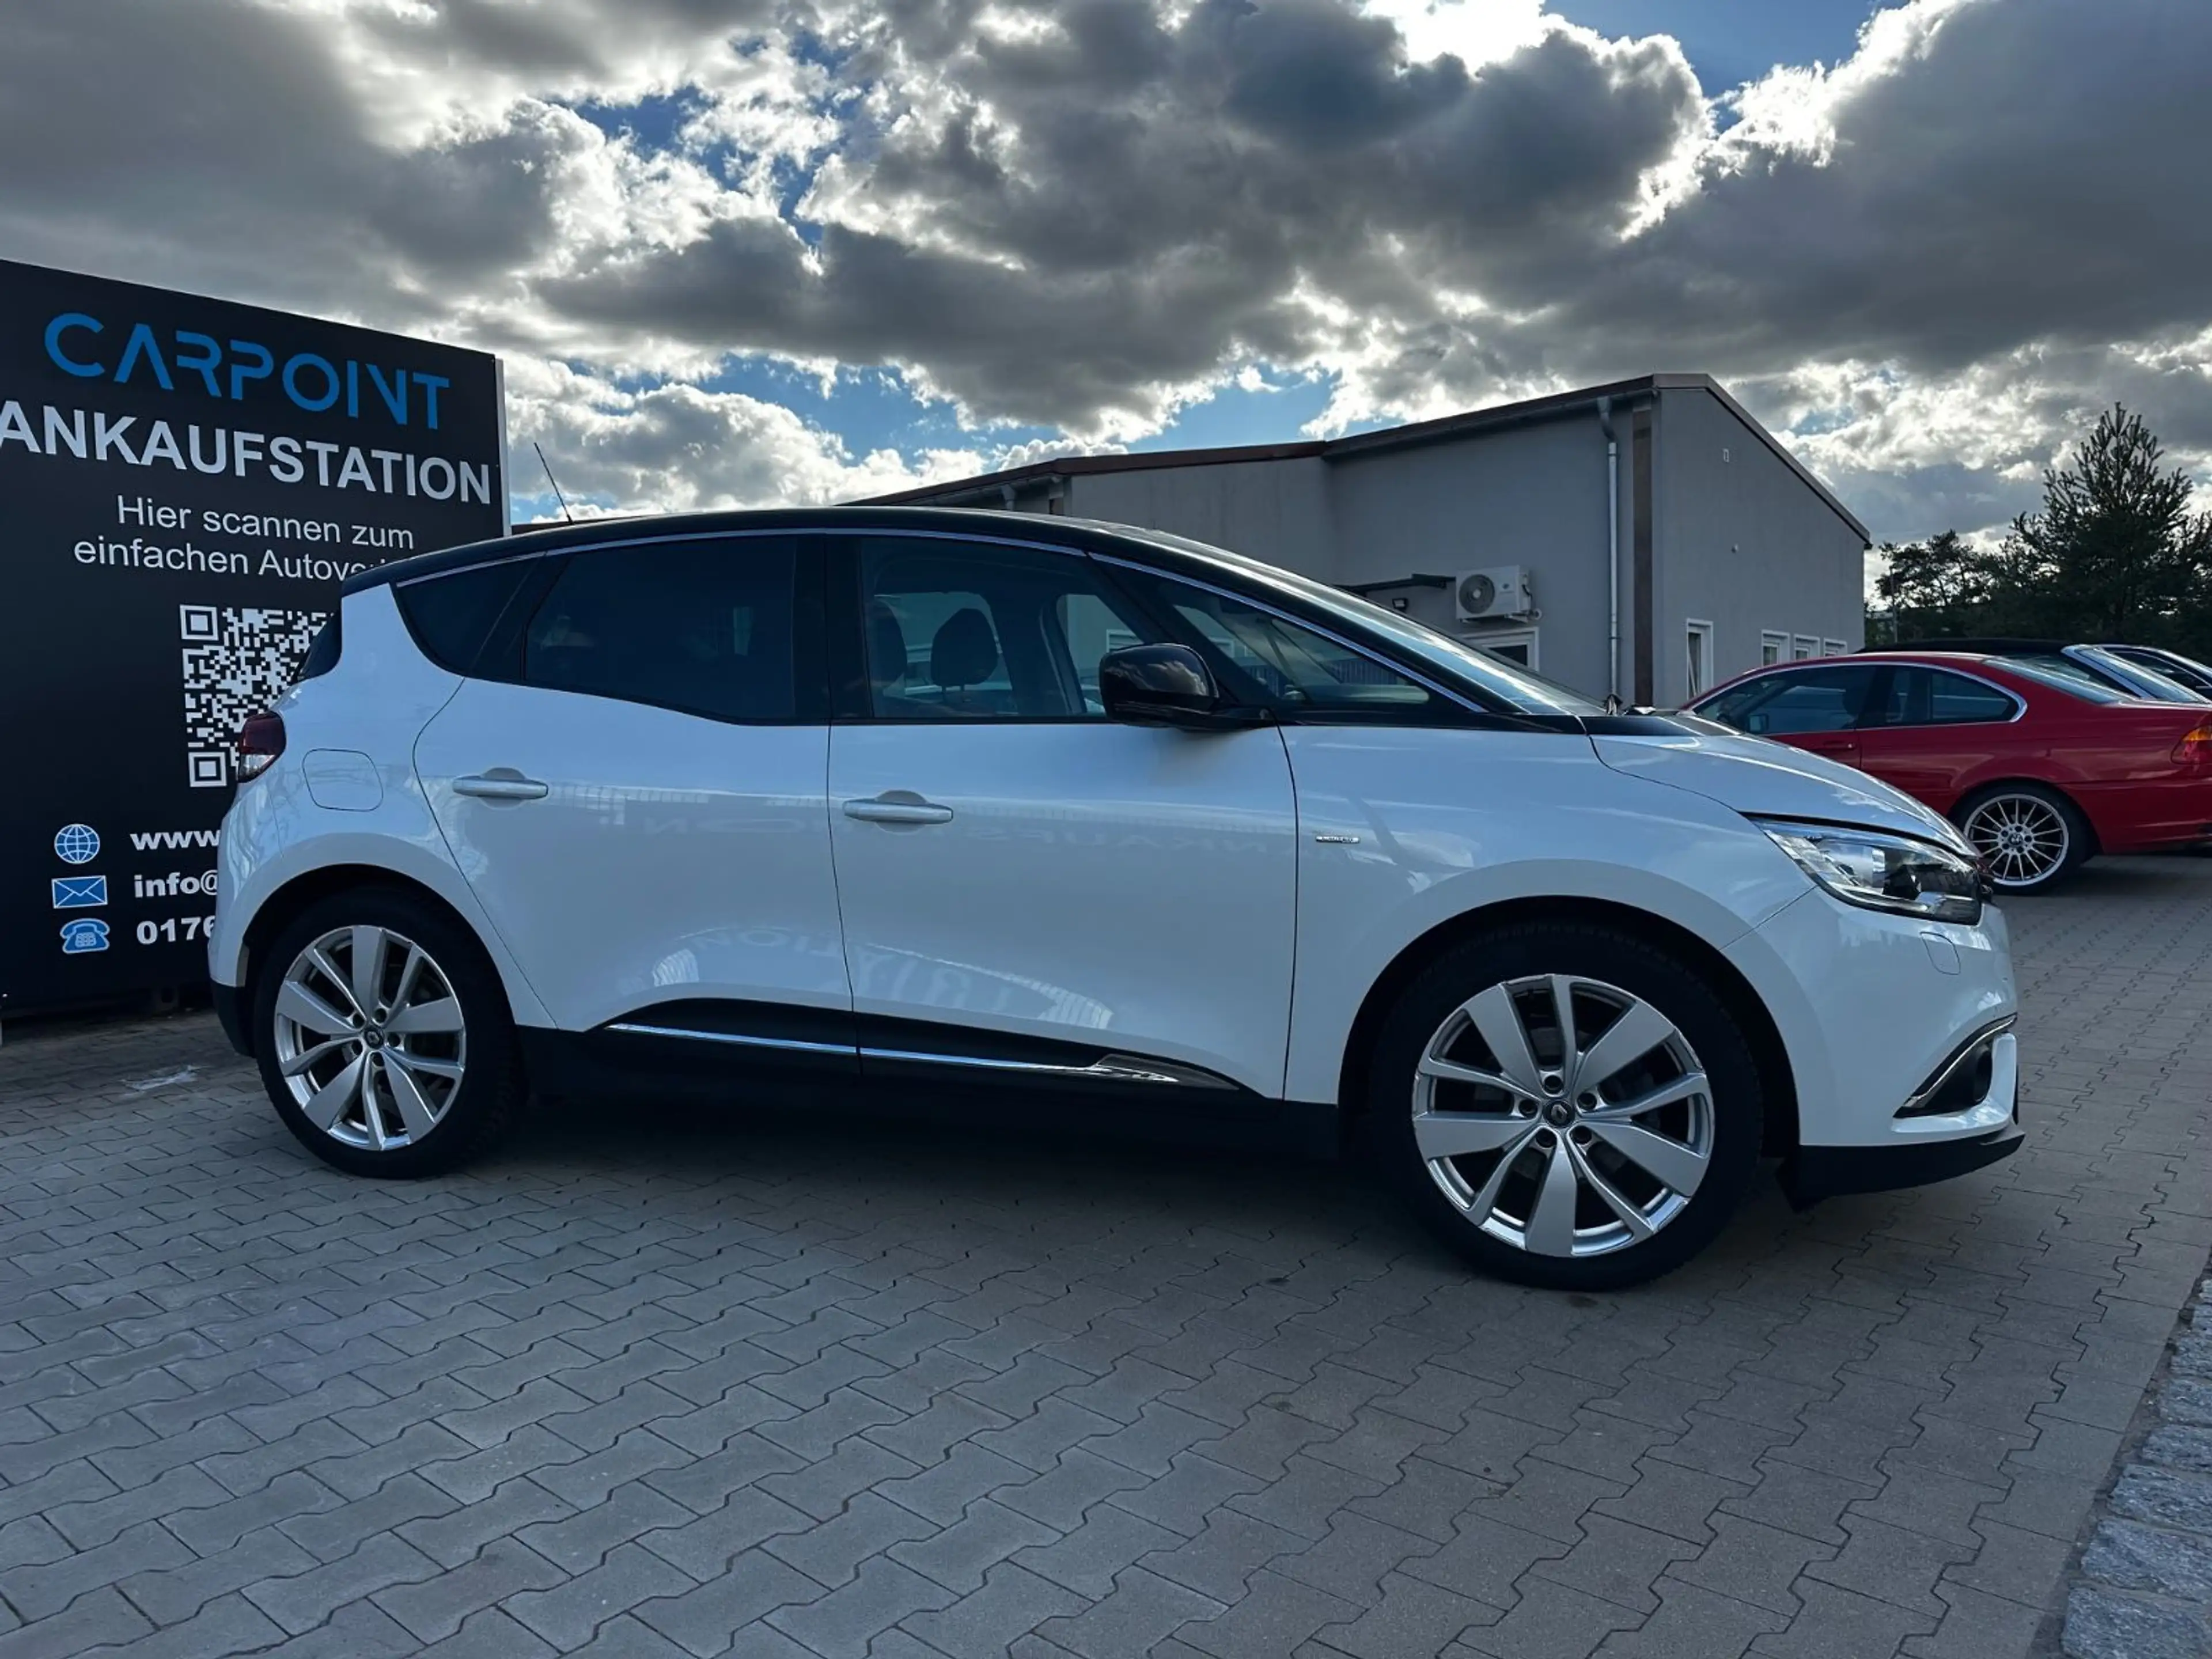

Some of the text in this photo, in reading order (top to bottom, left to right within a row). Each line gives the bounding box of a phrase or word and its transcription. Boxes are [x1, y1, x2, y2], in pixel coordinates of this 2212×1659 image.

[44, 313, 450, 429] CARPOINT
[0, 400, 491, 505] ANKAUFSTATION
[74, 535, 248, 574] einfachen
[117, 494, 414, 550] Hier scannen zum
